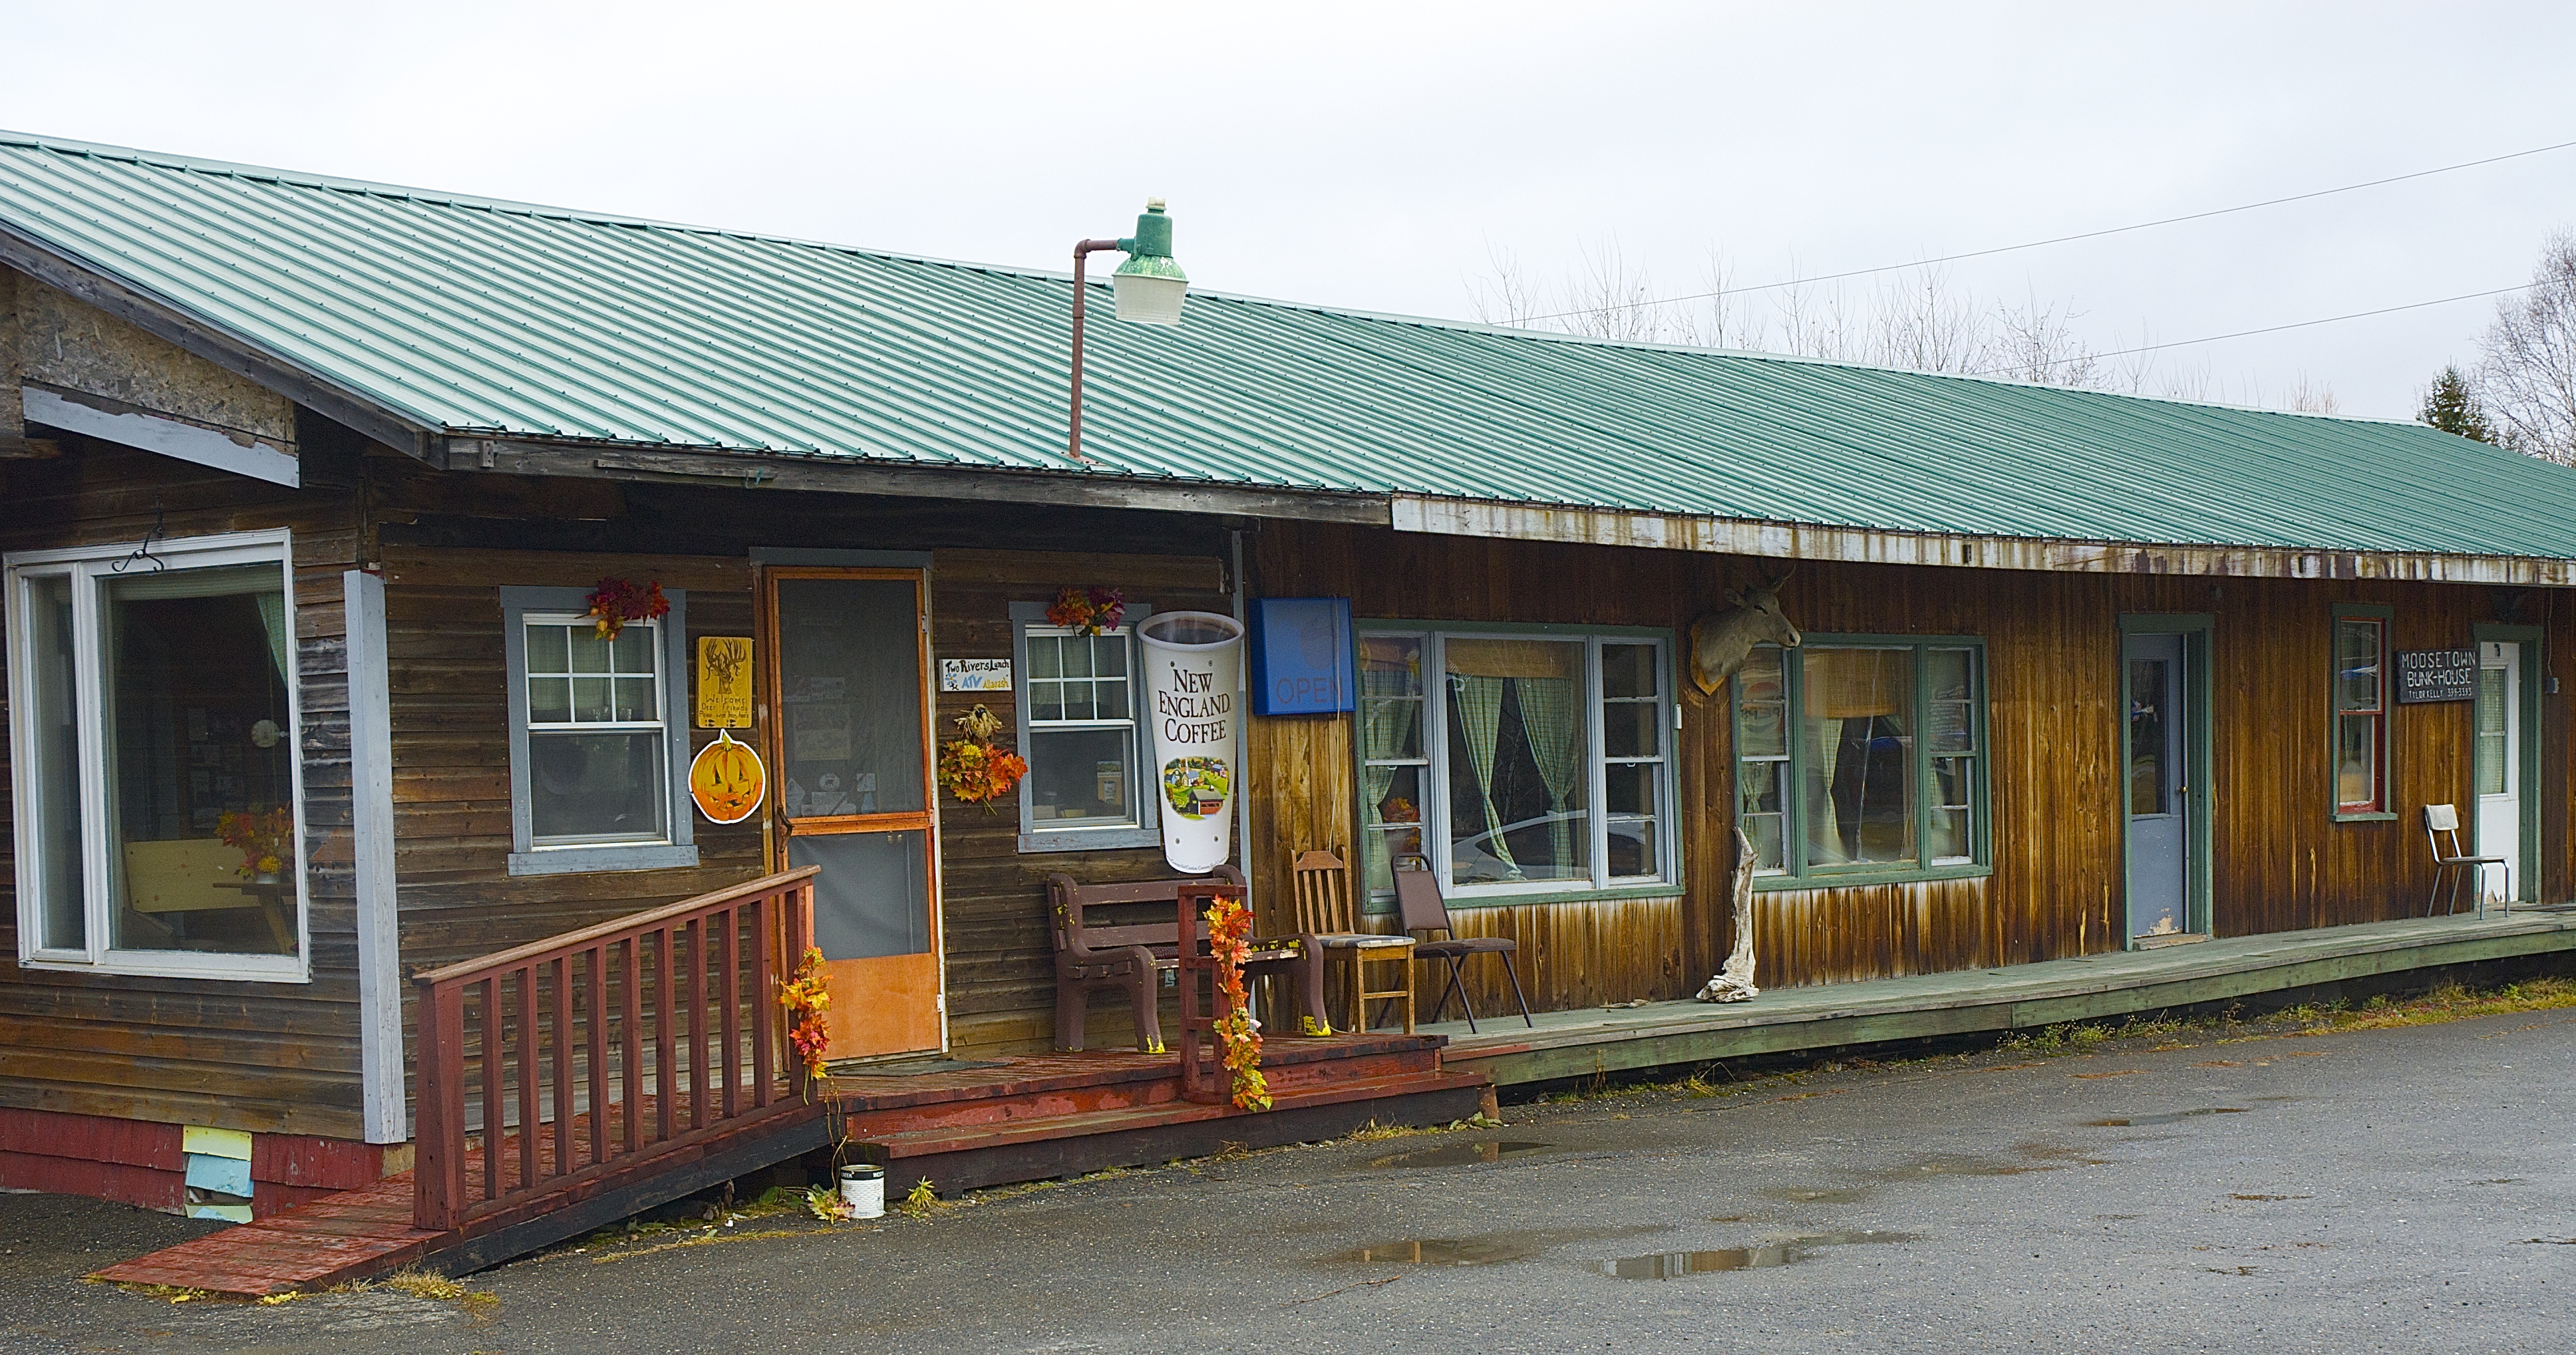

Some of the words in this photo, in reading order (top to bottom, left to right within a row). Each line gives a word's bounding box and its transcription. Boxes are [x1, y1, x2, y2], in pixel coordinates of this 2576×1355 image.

[945, 661, 959, 673] Two
[959, 660, 989, 673] Rivers
[988, 659, 1010, 671] Lunch
[2407, 668, 2472, 687] BUNK-HOUSE
[961, 675, 983, 689] ATV
[1173, 669, 1213, 693] NEW
[1276, 677, 1344, 705] OPEN
[1158, 690, 1230, 718] ENGLAND
[1165, 718, 1226, 744] COFFEE
